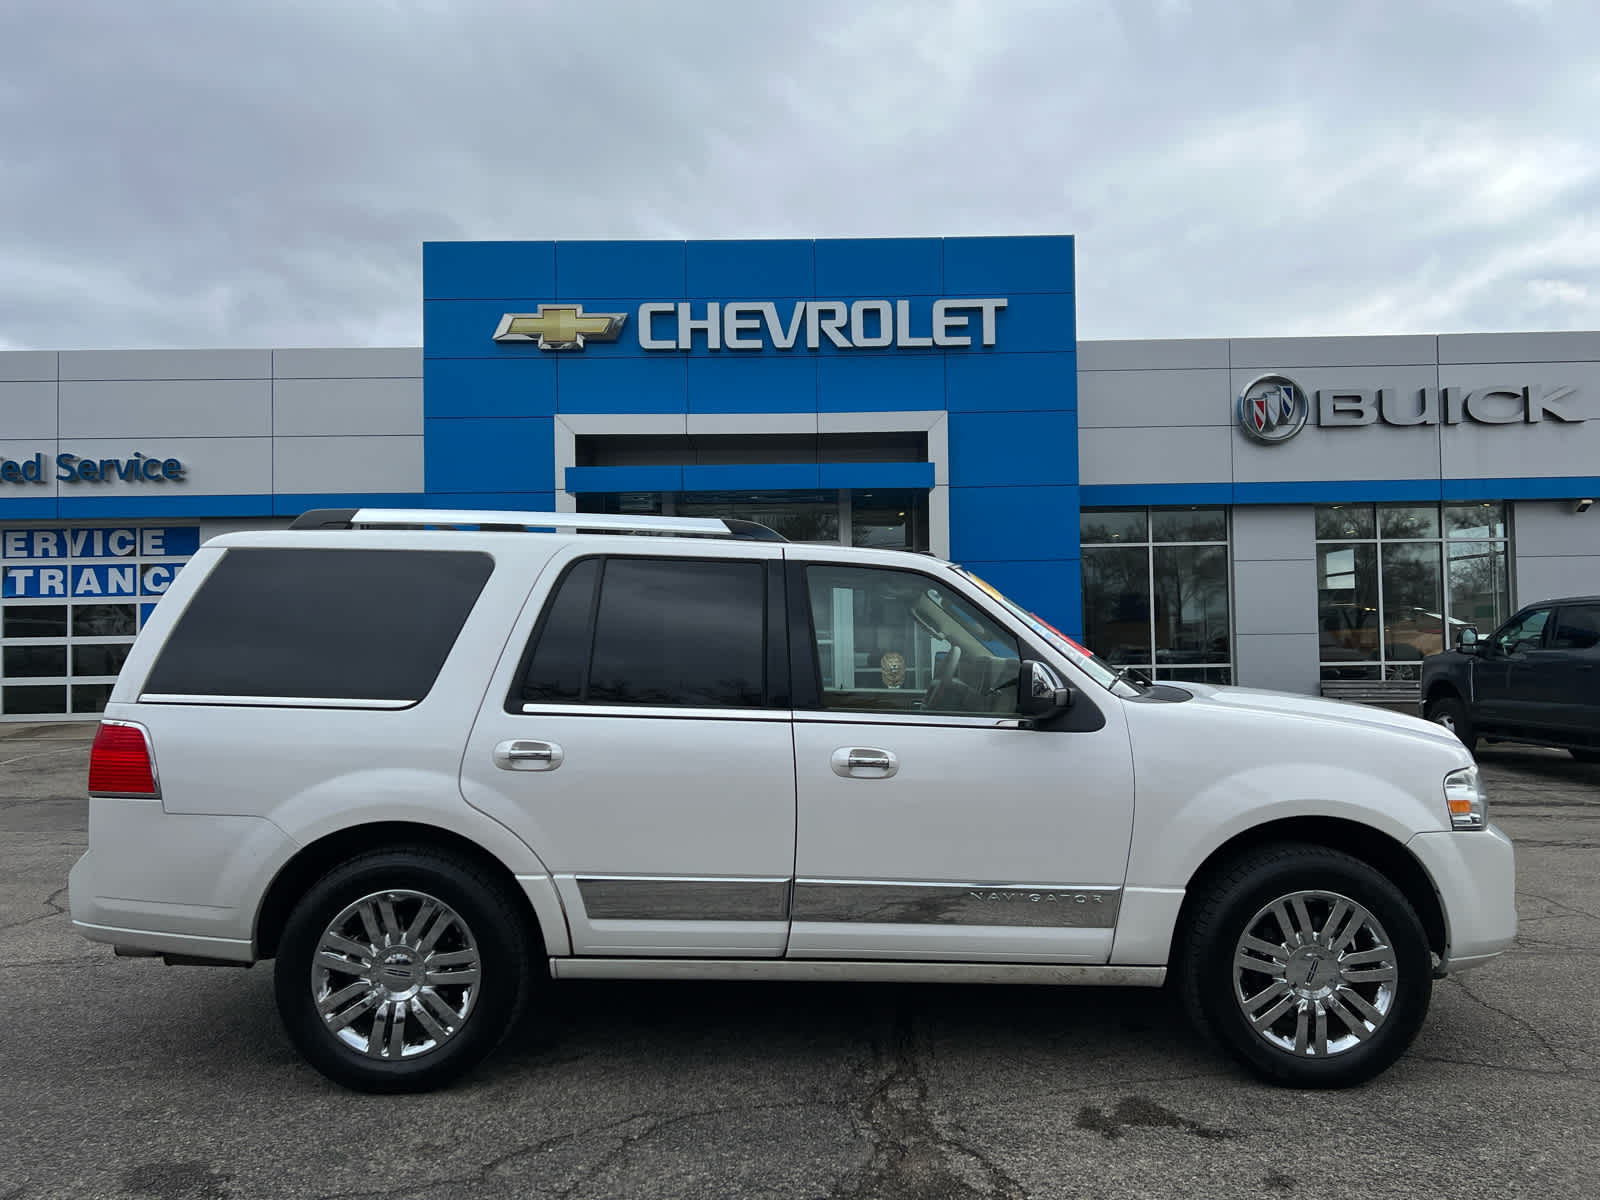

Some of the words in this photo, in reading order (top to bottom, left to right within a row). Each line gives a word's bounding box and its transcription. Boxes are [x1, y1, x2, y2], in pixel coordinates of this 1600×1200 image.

[638, 298, 1008, 350] CHEVROLET
[1316, 385, 1586, 428] BUICK
[56, 451, 182, 481] Service
[5, 529, 165, 557] ERVICE
[969, 891, 1104, 904] NAVIGATOR
